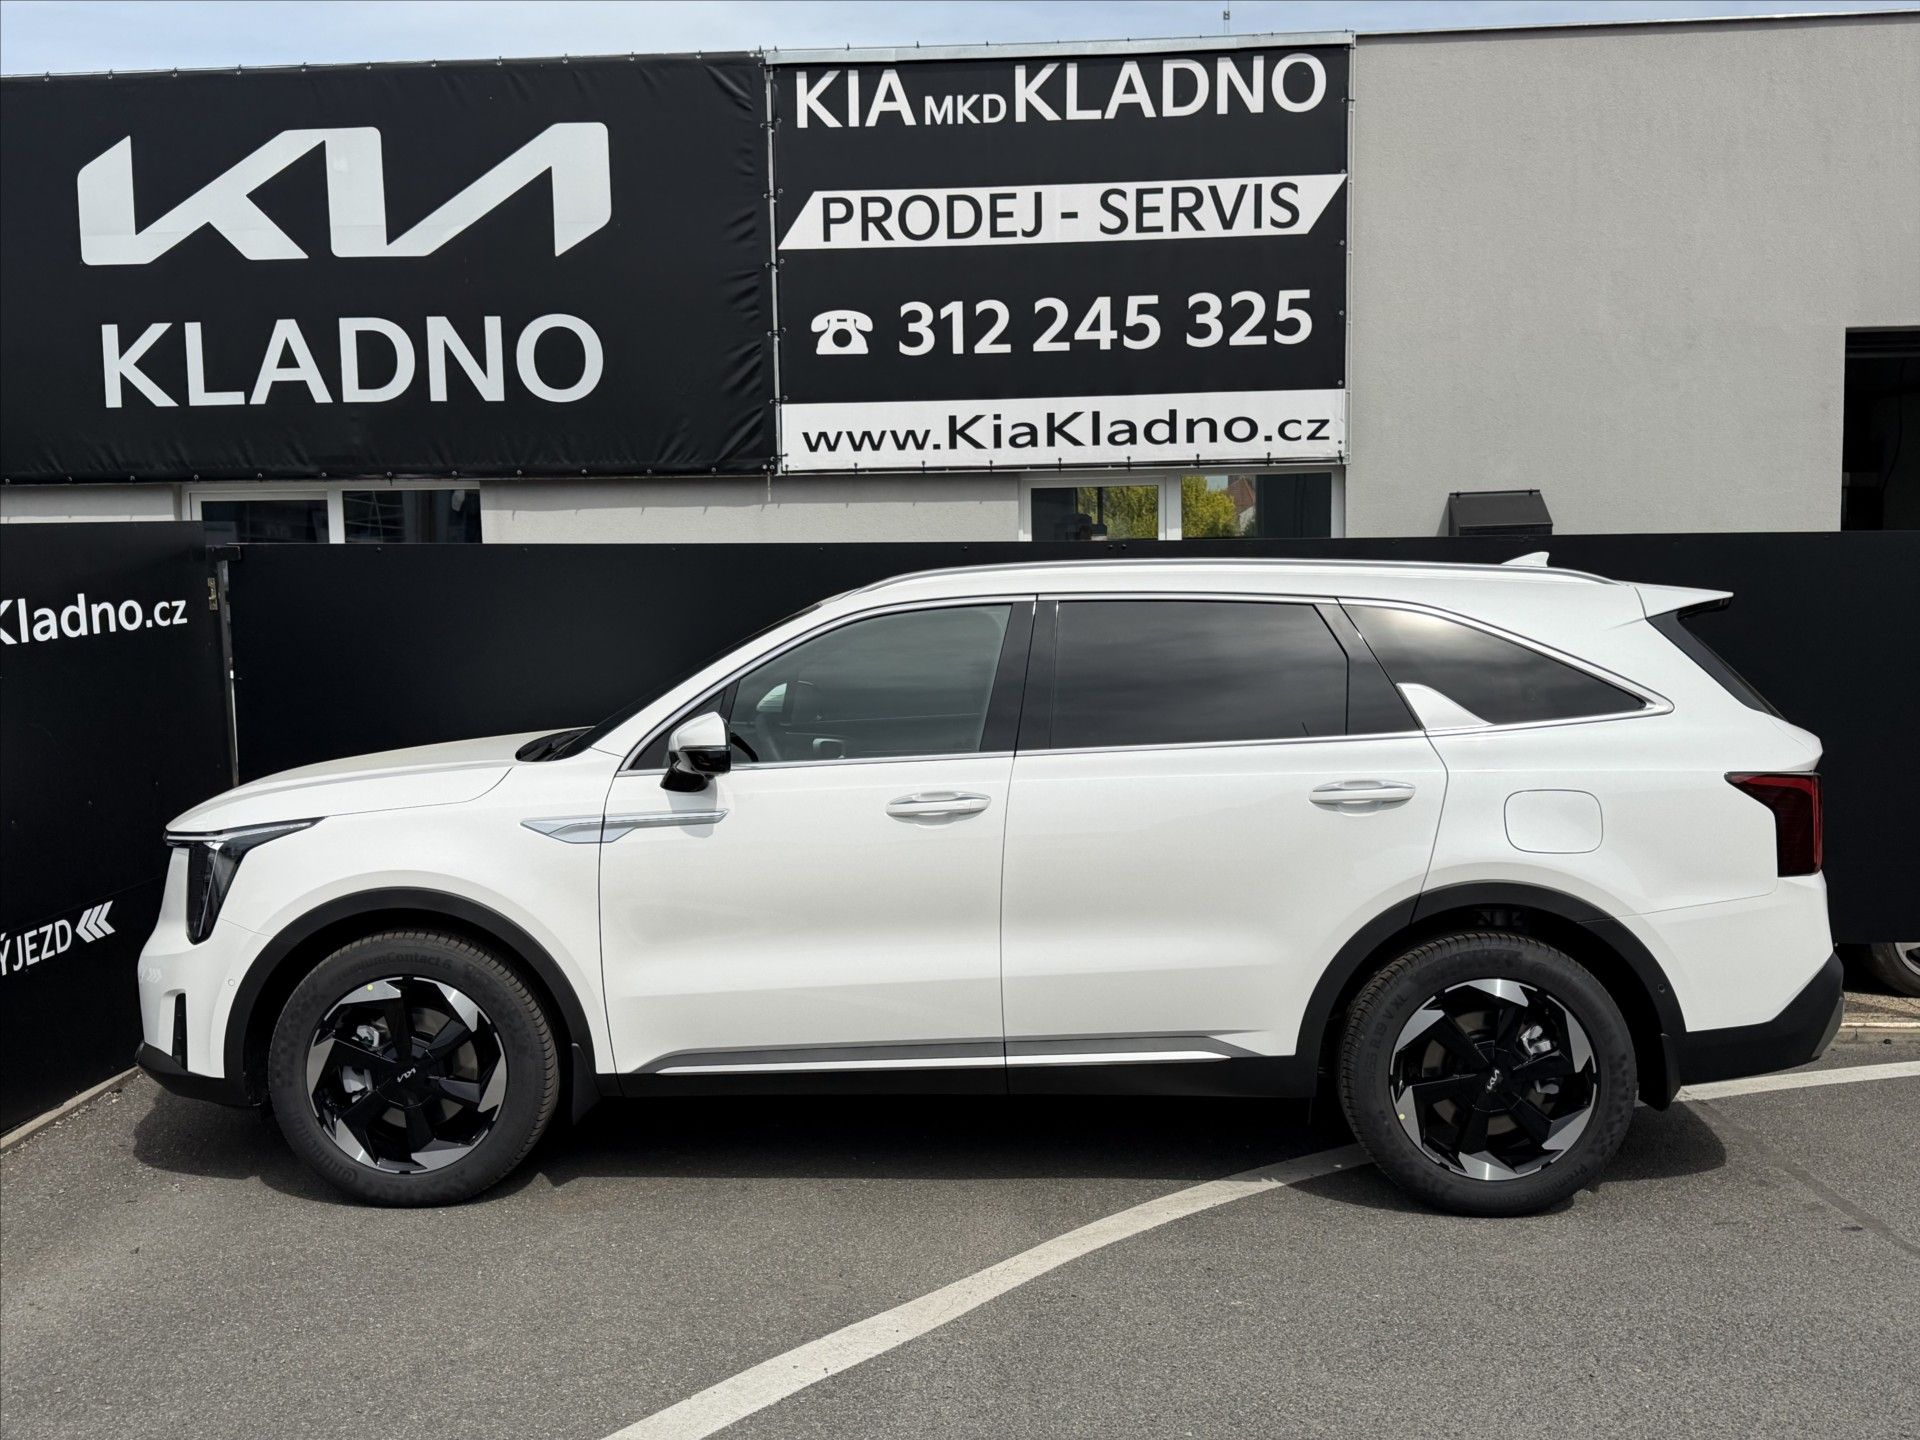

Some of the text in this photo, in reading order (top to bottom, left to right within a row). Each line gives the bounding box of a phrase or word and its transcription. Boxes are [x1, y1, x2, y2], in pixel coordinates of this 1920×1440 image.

[797, 53, 1327, 128] KIA MKD KLADNO
[823, 192, 1042, 241] PRODEJ
[1098, 182, 1300, 234] SERVIS
[899, 290, 1312, 355] 312 245 325
[102, 314, 603, 408] KLADNO
[803, 409, 1329, 452] www.KiaKladno.cz
